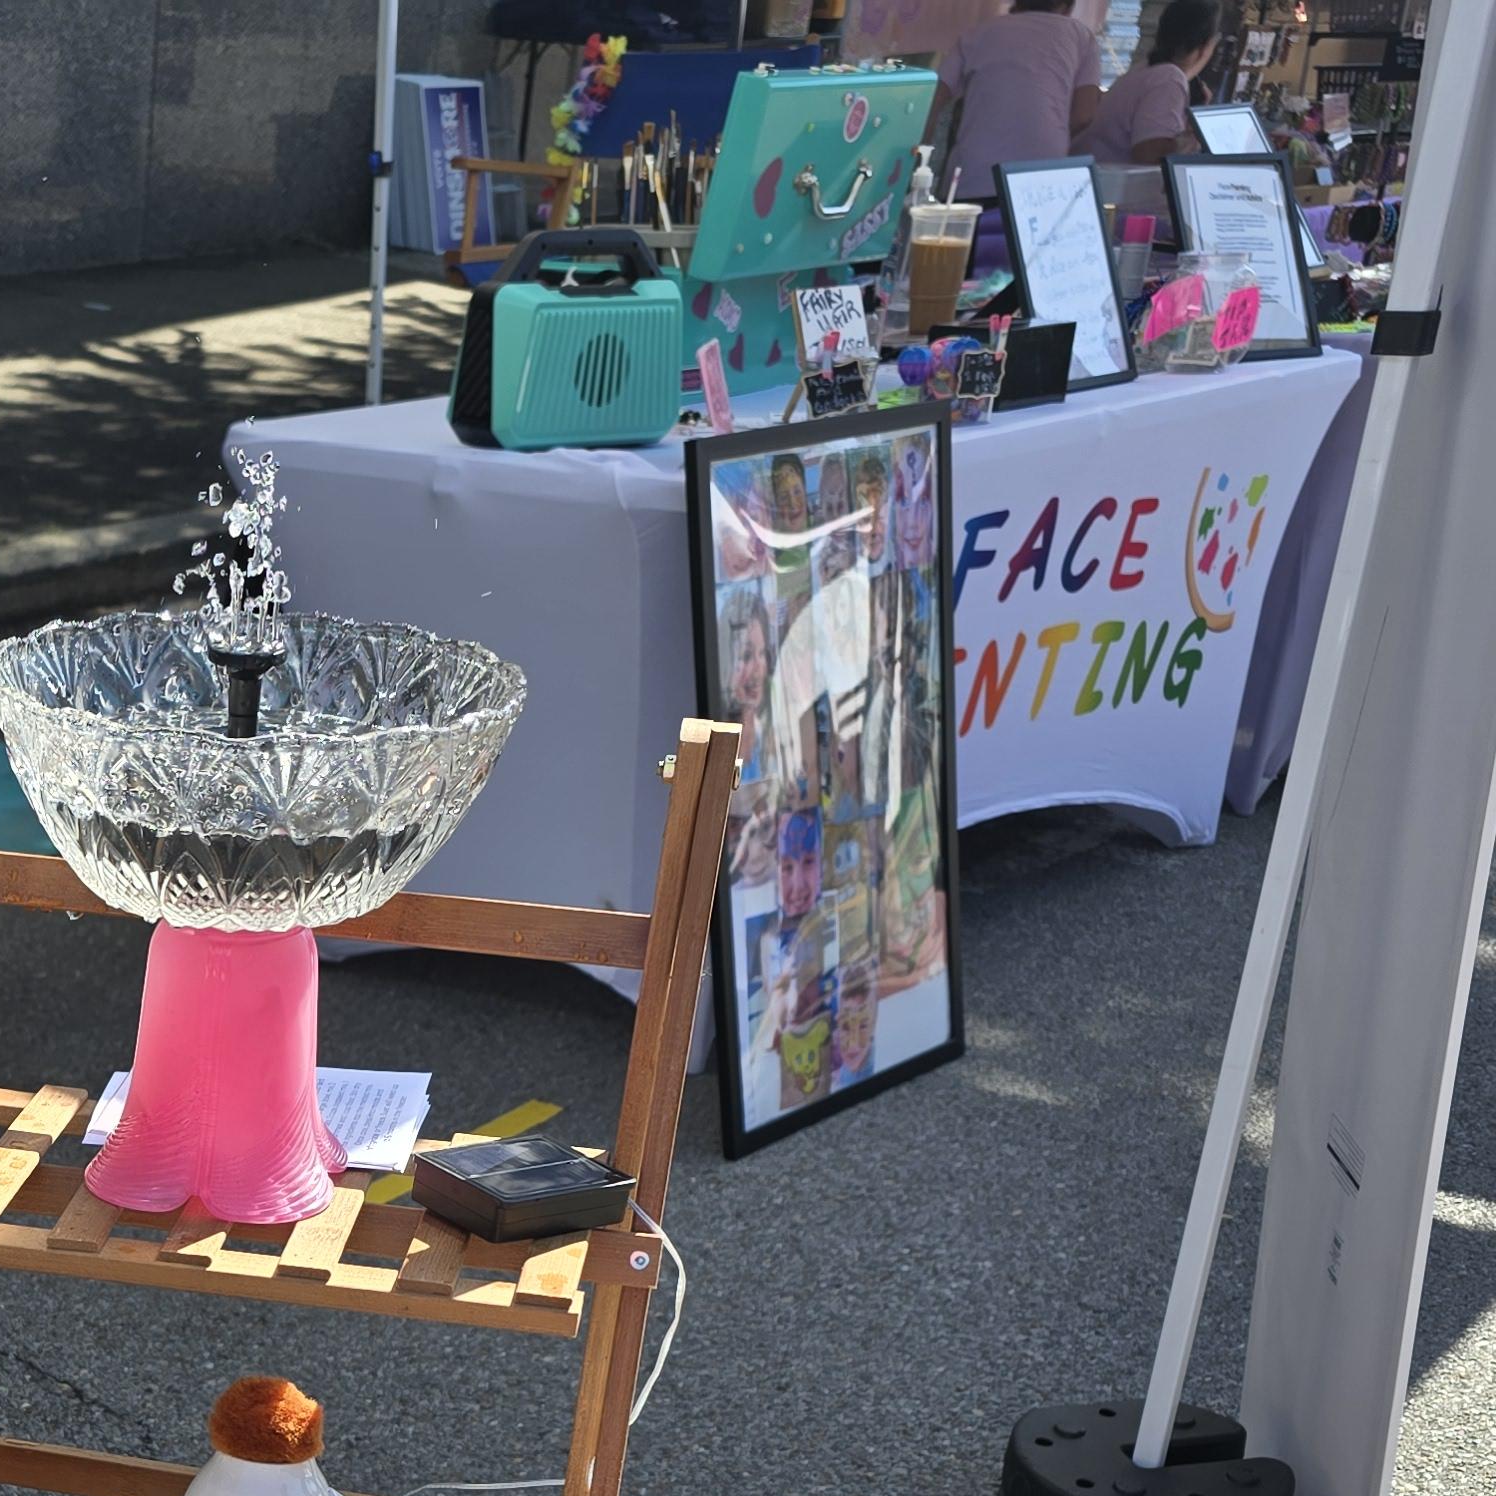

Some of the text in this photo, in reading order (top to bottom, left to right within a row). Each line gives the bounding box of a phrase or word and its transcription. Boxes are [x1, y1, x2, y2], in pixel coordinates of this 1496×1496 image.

[800, 288, 844, 323] FAIRY
[952, 497, 1159, 613] FACE
[953, 616, 1208, 738] NTING
